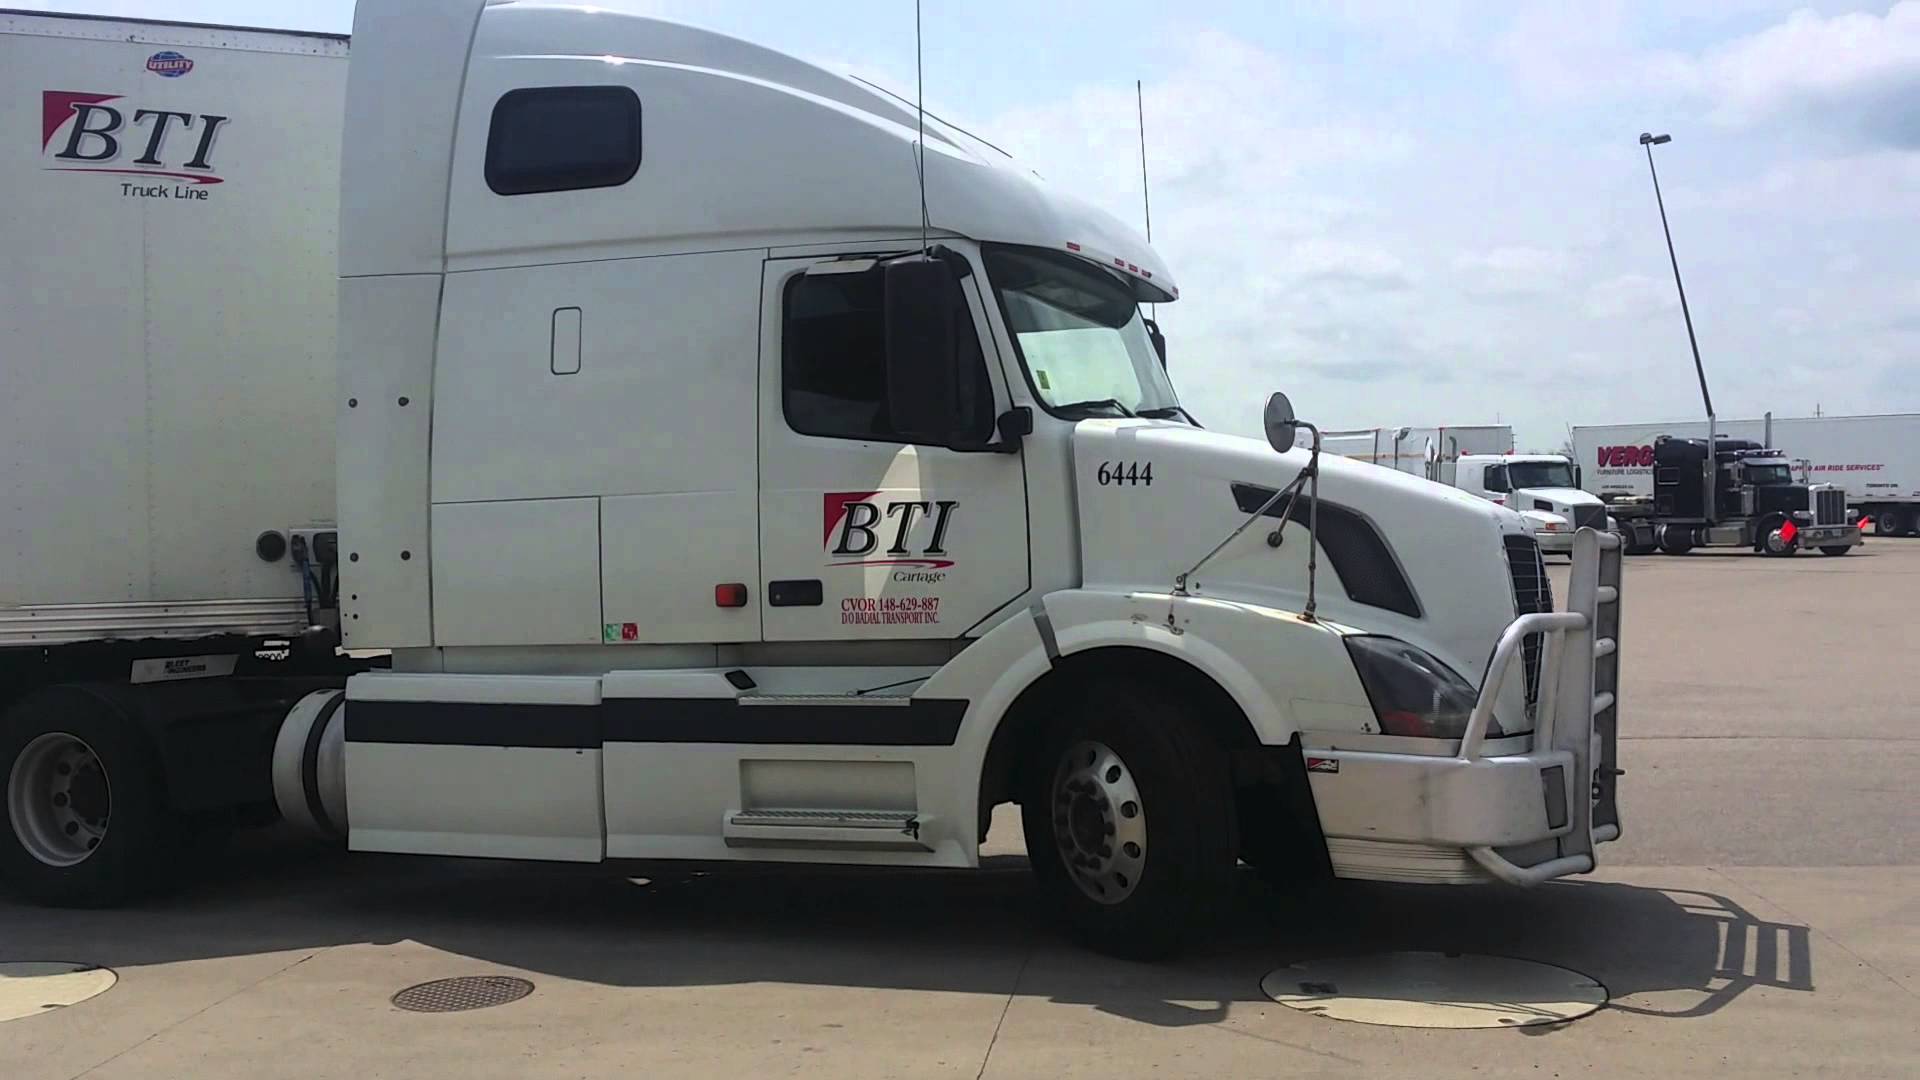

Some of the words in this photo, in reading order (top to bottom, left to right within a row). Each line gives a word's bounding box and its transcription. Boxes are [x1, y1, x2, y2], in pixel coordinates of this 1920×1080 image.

[149, 60, 193, 70] UTILITY
[54, 103, 228, 169] BTI
[121, 183, 169, 199] Truck
[174, 186, 209, 201] Line
[1097, 461, 1153, 486] 6444
[832, 501, 959, 557] BTI
[893, 571, 946, 584] Cartage
[841, 598, 876, 611] CVOR
[879, 597, 939, 611] 148-629-887
[882, 612, 923, 624] TRANSPORT
